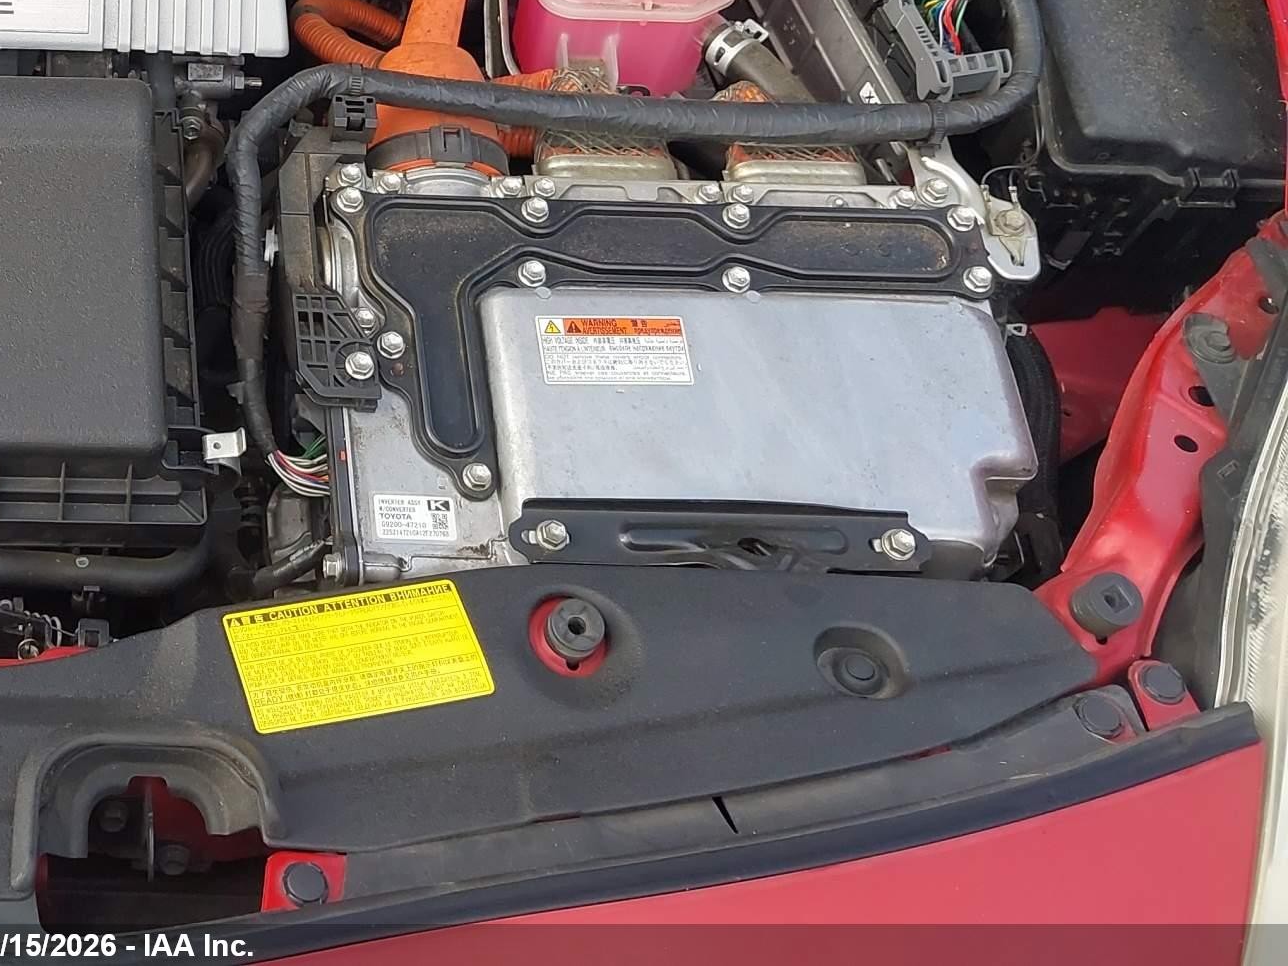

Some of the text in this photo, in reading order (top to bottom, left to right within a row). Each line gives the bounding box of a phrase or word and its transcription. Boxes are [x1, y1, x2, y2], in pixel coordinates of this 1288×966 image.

[390, 584, 449, 602] ВНИМАНИЕ
[269, 605, 319, 621] CAUTION
[324, 595, 385, 612] ATTENTION
